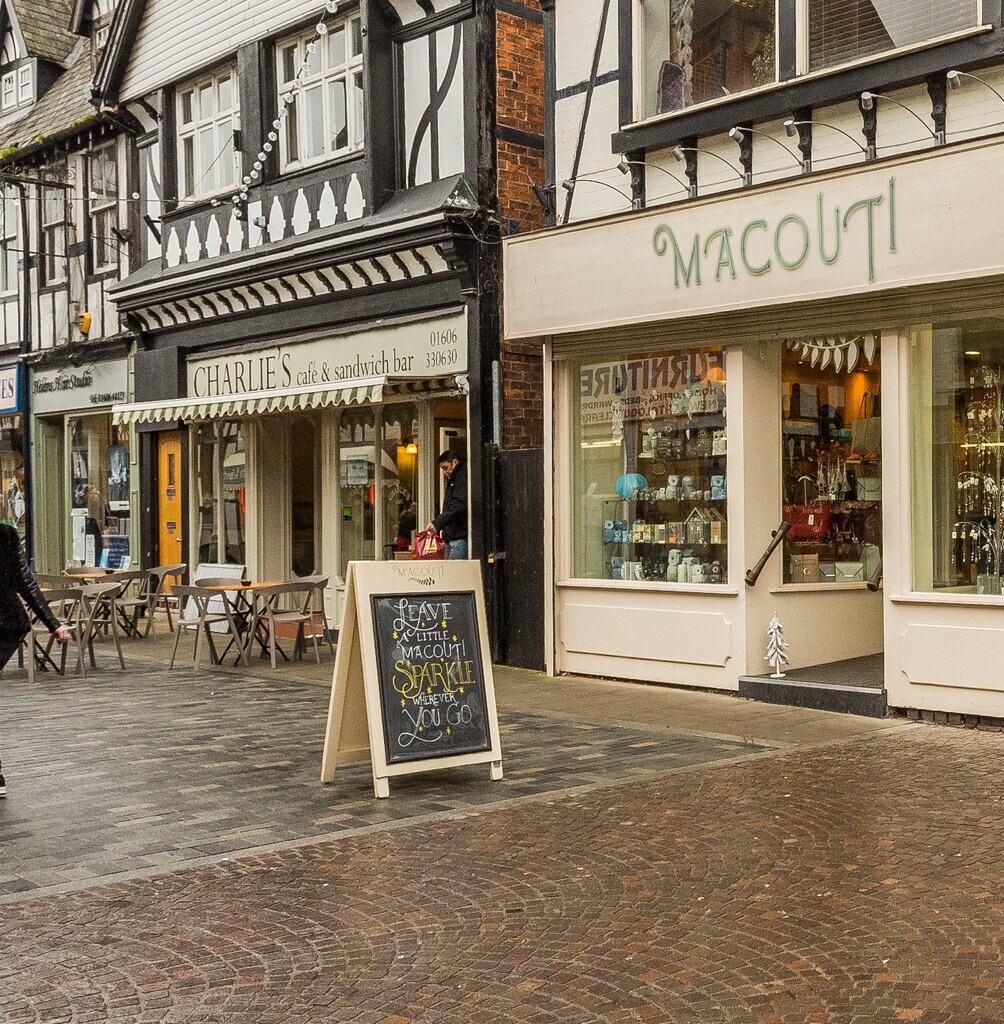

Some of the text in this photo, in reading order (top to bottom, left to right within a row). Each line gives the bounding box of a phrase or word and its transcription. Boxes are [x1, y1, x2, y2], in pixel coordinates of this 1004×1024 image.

[653, 175, 896, 288] MACOUTI
[430, 328, 457, 347] 01606
[426, 349, 457, 369] 330630
[194, 346, 414, 397] CHARLIE'S café & sandwich bar
[0, 378, 14, 399] ES
[392, 564, 444, 579] MACOUTI
[393, 598, 453, 633] LEAVE
[417, 630, 450, 642] LITTLE
[399, 640, 466, 661] MACOUTI
[392, 660, 476, 699] SPARKLE
[412, 692, 459, 706] WHEREVER
[446, 704, 473, 725] GO
